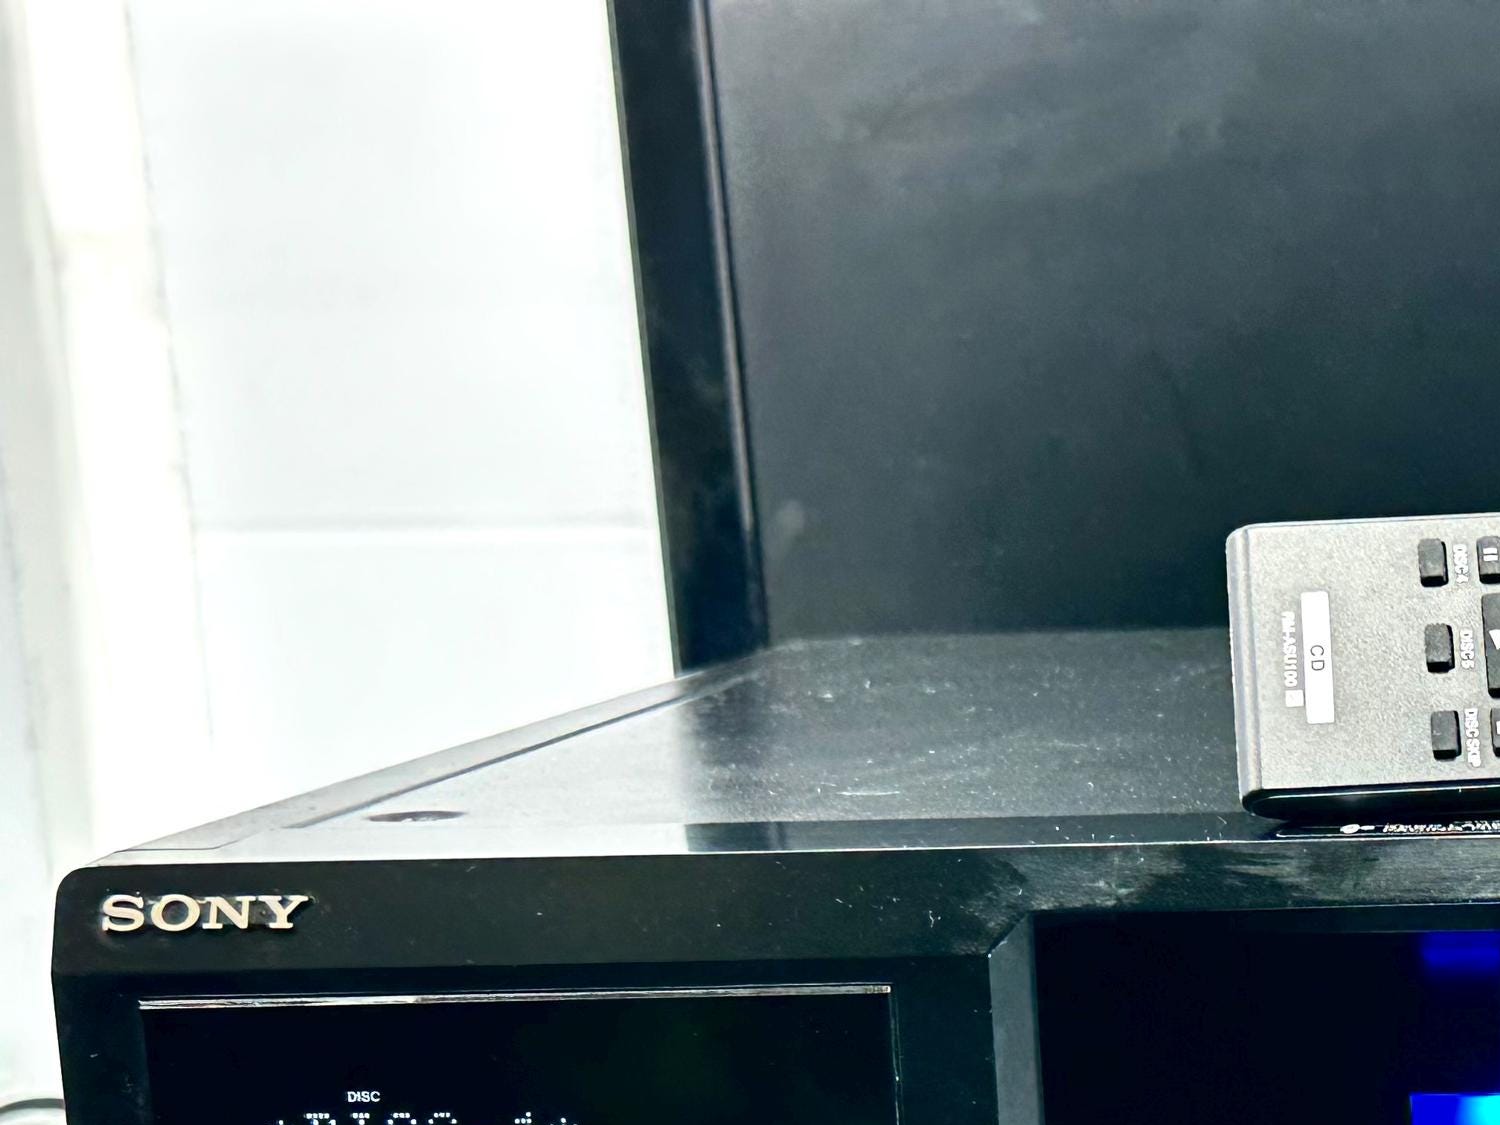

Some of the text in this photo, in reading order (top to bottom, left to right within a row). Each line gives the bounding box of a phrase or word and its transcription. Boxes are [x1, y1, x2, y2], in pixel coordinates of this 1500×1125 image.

[1310, 645, 1325, 671] CD
[100, 893, 310, 934] SONY
[346, 1089, 381, 1104] DISC
